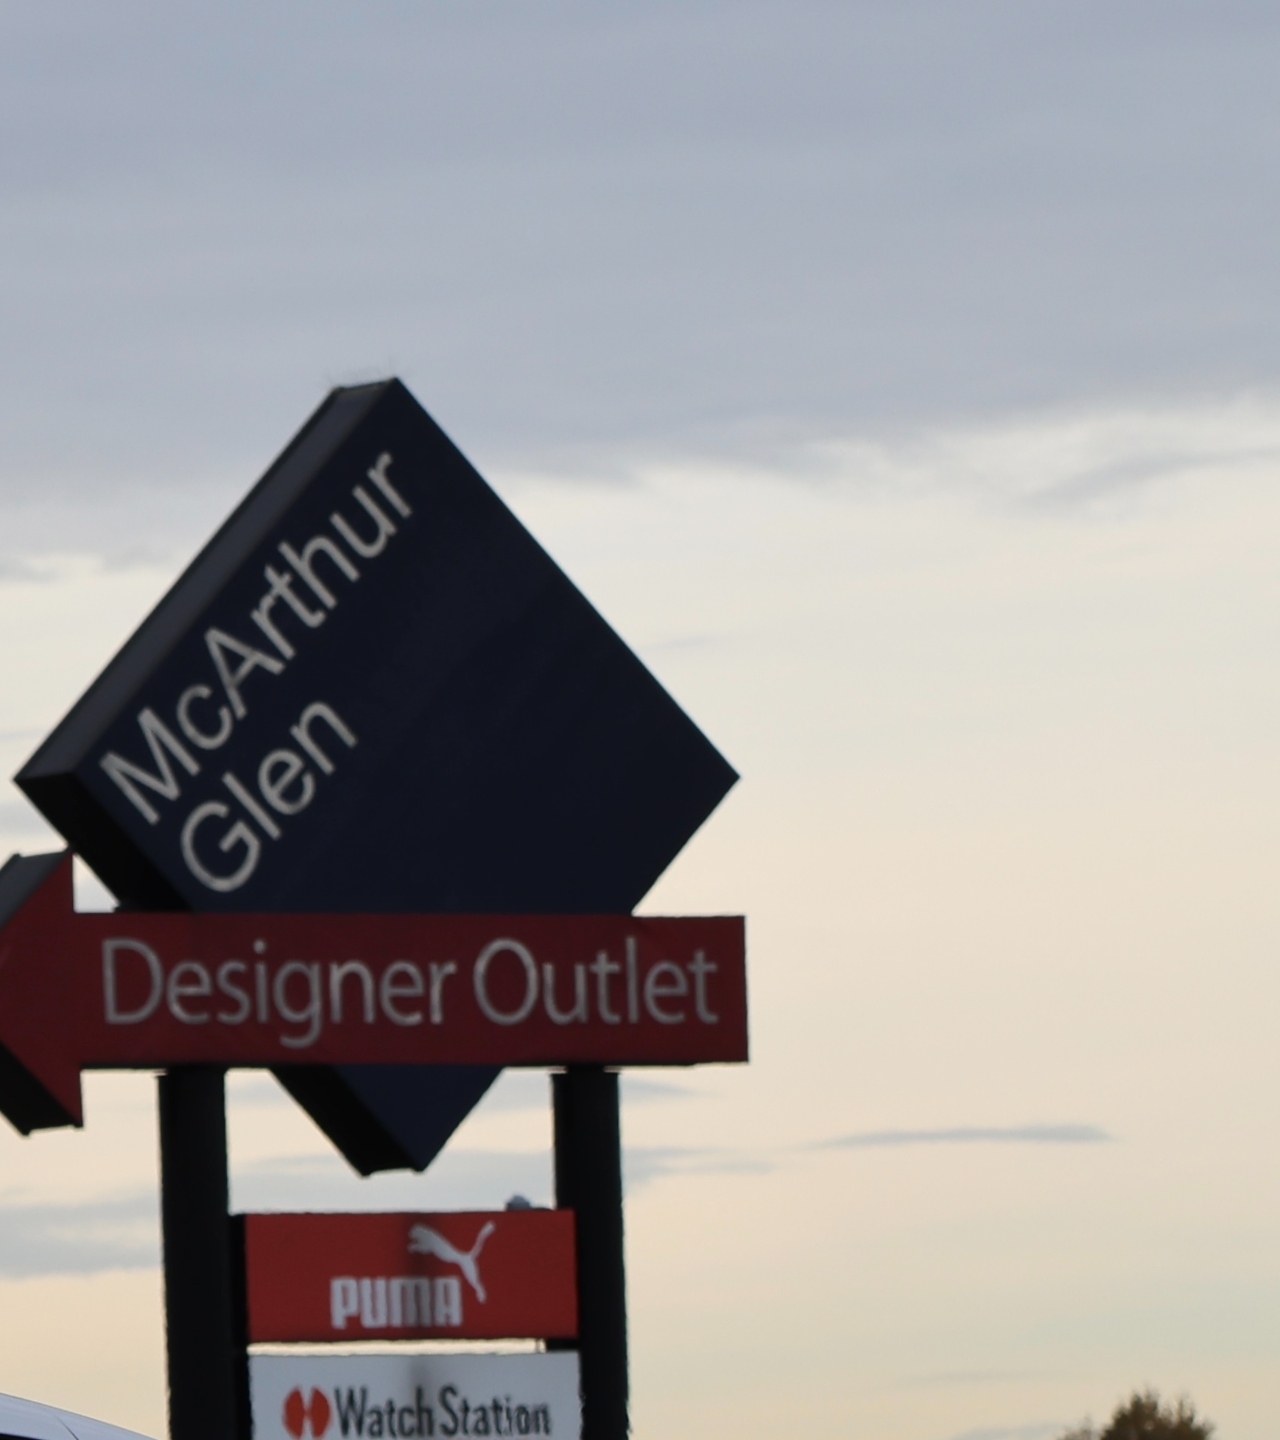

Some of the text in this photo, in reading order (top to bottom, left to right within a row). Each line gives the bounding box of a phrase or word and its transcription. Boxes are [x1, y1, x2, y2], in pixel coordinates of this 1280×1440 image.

[99, 451, 413, 826] McArthur
[180, 701, 358, 893] Glen
[101, 936, 719, 1049] Designer Outlet
[330, 1275, 463, 1330] PUMA
[334, 1384, 552, 1440] Watch Station
